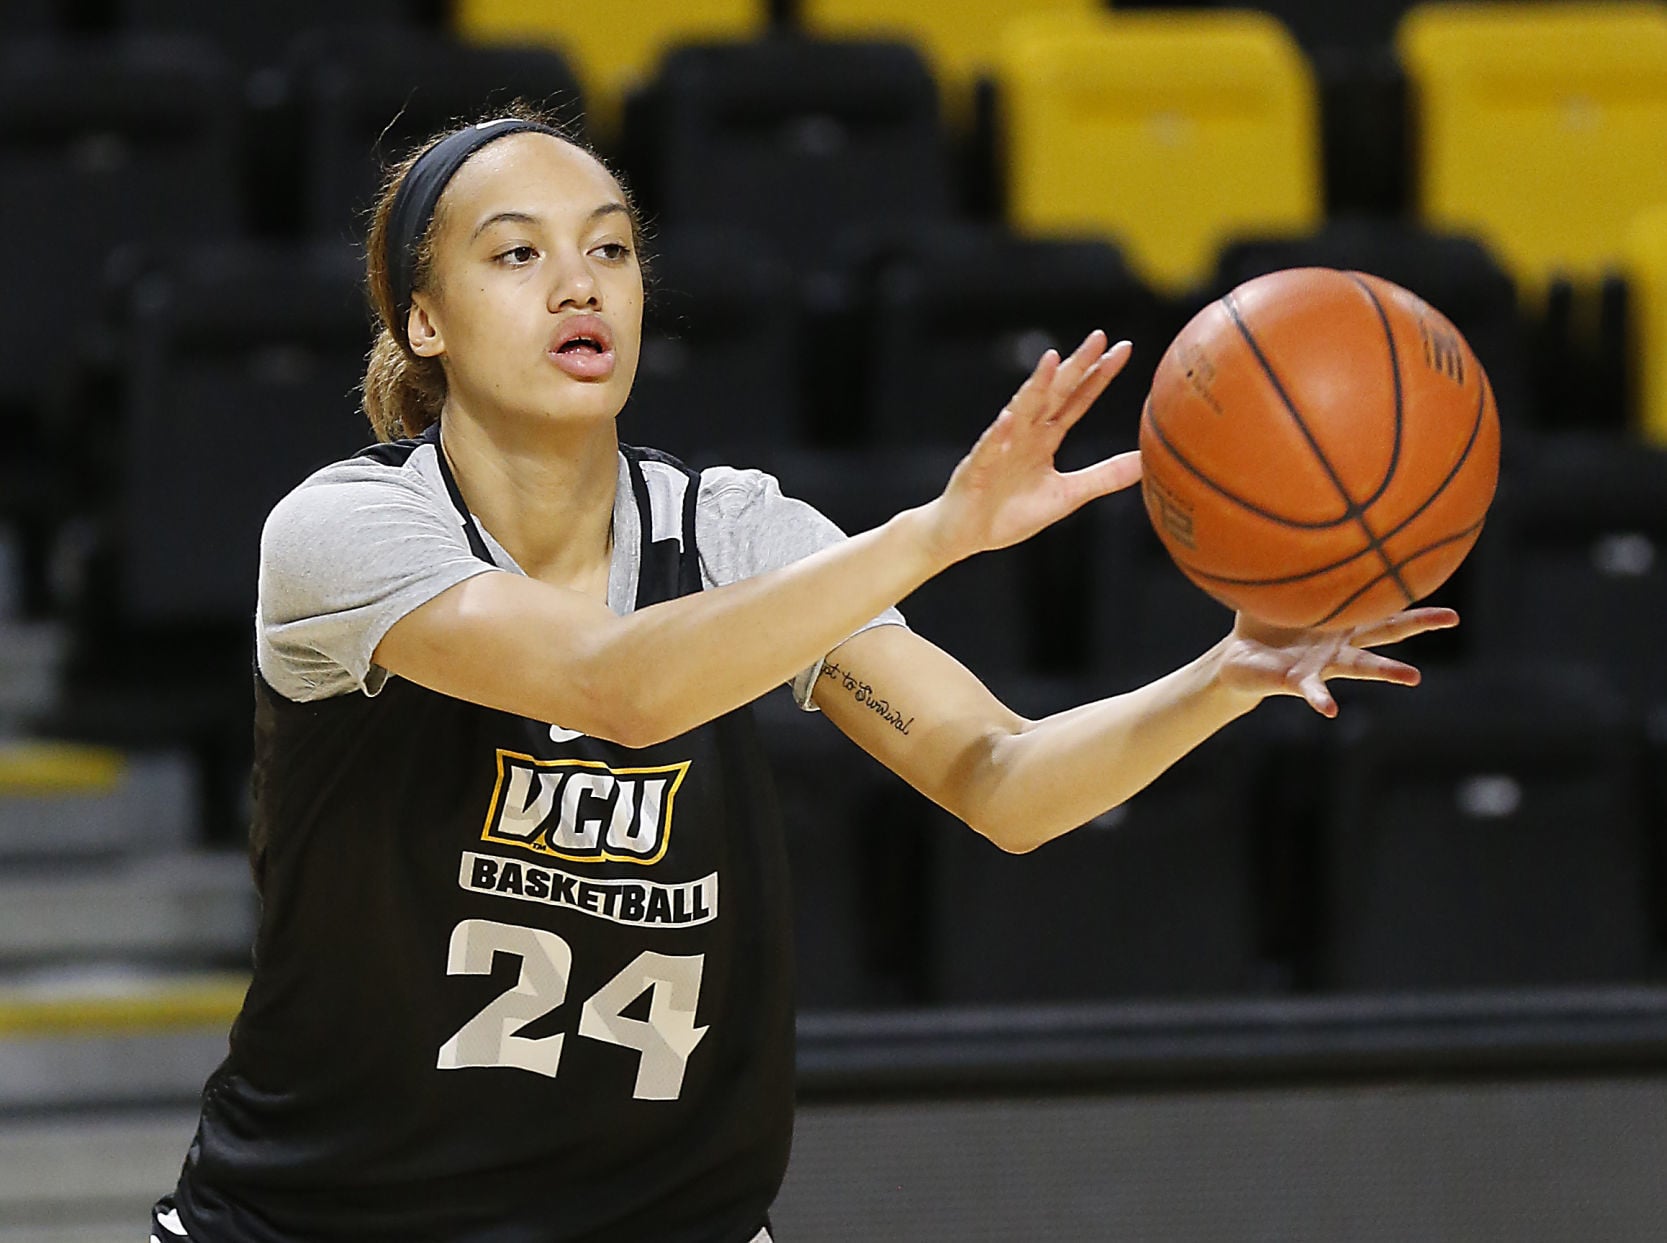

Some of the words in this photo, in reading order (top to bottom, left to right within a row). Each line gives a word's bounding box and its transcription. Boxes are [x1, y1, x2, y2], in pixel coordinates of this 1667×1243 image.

[842, 671, 858, 691] to
[855, 681, 915, 736] Survival
[498, 765, 667, 853] VCU
[471, 857, 710, 923] BASKETBALL
[436, 918, 711, 1100] 24
